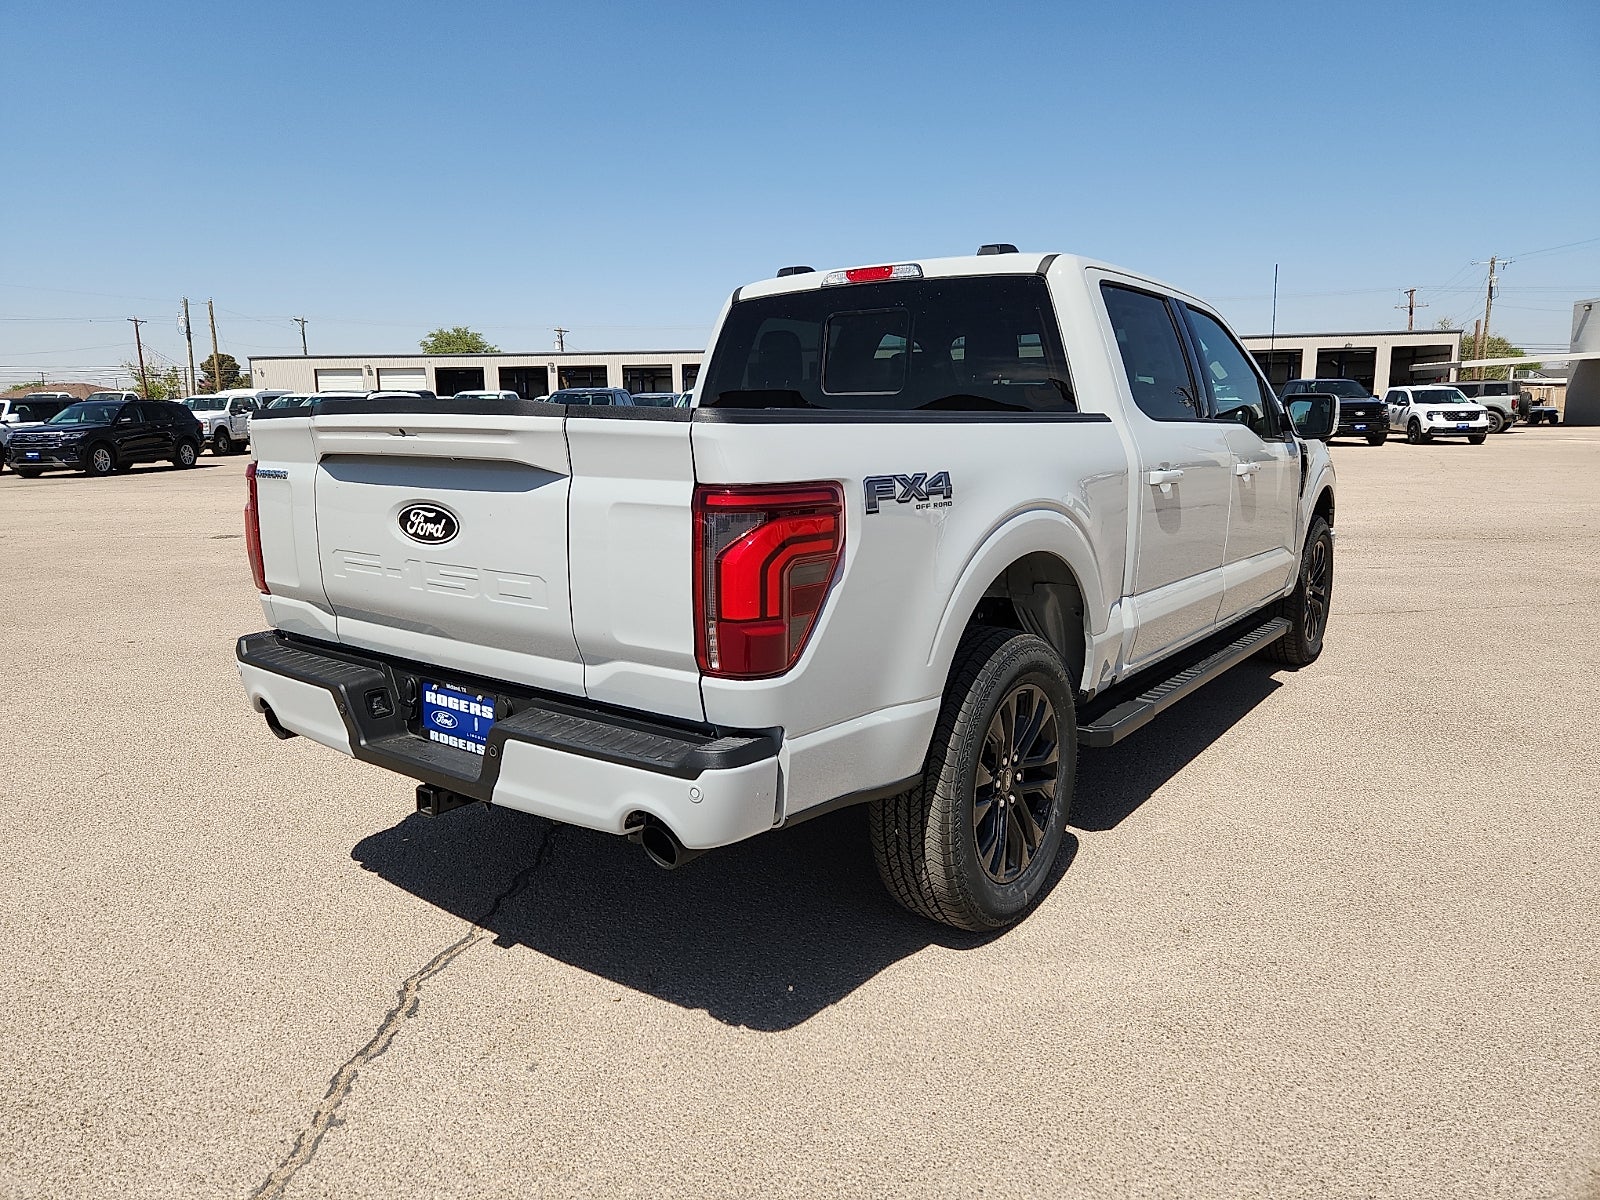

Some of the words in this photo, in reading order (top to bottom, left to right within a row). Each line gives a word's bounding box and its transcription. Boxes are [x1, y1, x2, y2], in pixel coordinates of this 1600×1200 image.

[863, 471, 953, 515] FX4
[406, 509, 447, 539] Ford
[332, 548, 549, 610] F-150
[425, 690, 494, 720] ROGERS
[429, 729, 486, 756] ROGERS
